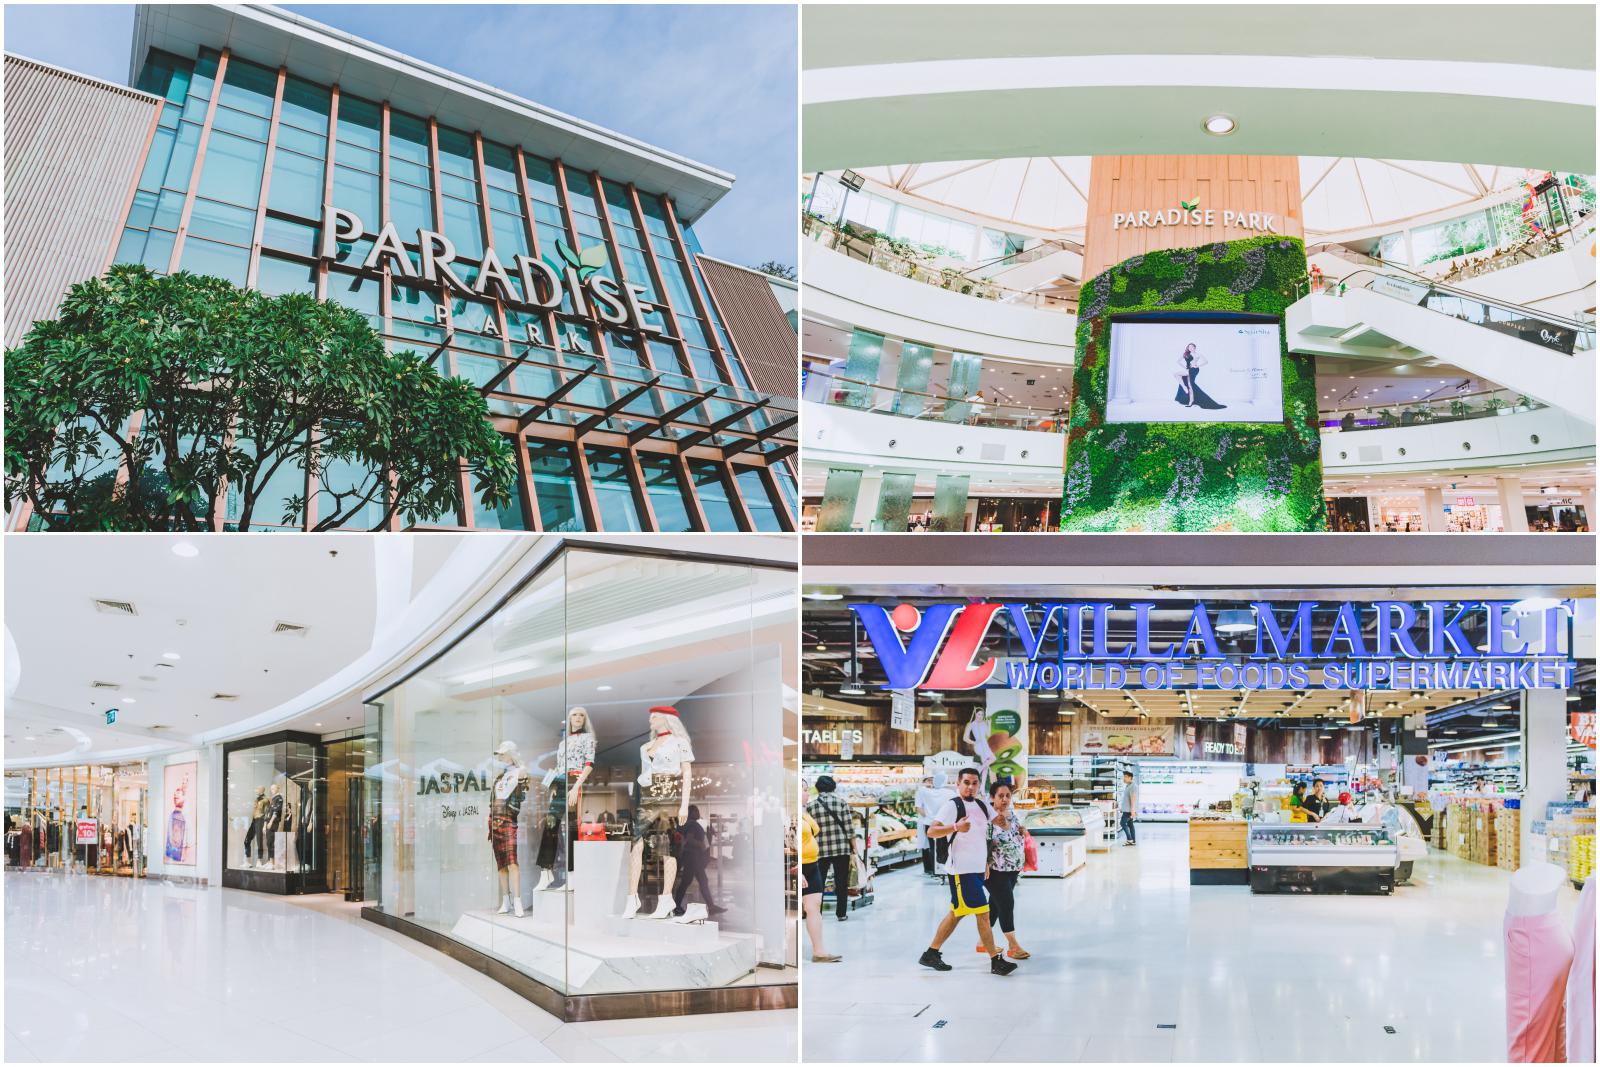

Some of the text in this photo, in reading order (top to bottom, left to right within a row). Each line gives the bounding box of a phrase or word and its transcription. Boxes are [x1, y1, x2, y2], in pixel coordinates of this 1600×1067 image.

[1113, 209, 1277, 234] PARADISE PARK
[321, 204, 662, 335] PARADISE
[433, 303, 586, 353] PARK
[1002, 602, 1227, 661] VILLA
[1250, 600, 1577, 661] MARKET
[1006, 661, 1578, 691] WORLD OF FOODS SUPERMARKET
[942, 756, 967, 767] Pure
[1204, 741, 1225, 754] READY
[1226, 743, 1234, 755] TO
[416, 769, 492, 796] JASPAL
[462, 804, 480, 817] JASPAL
